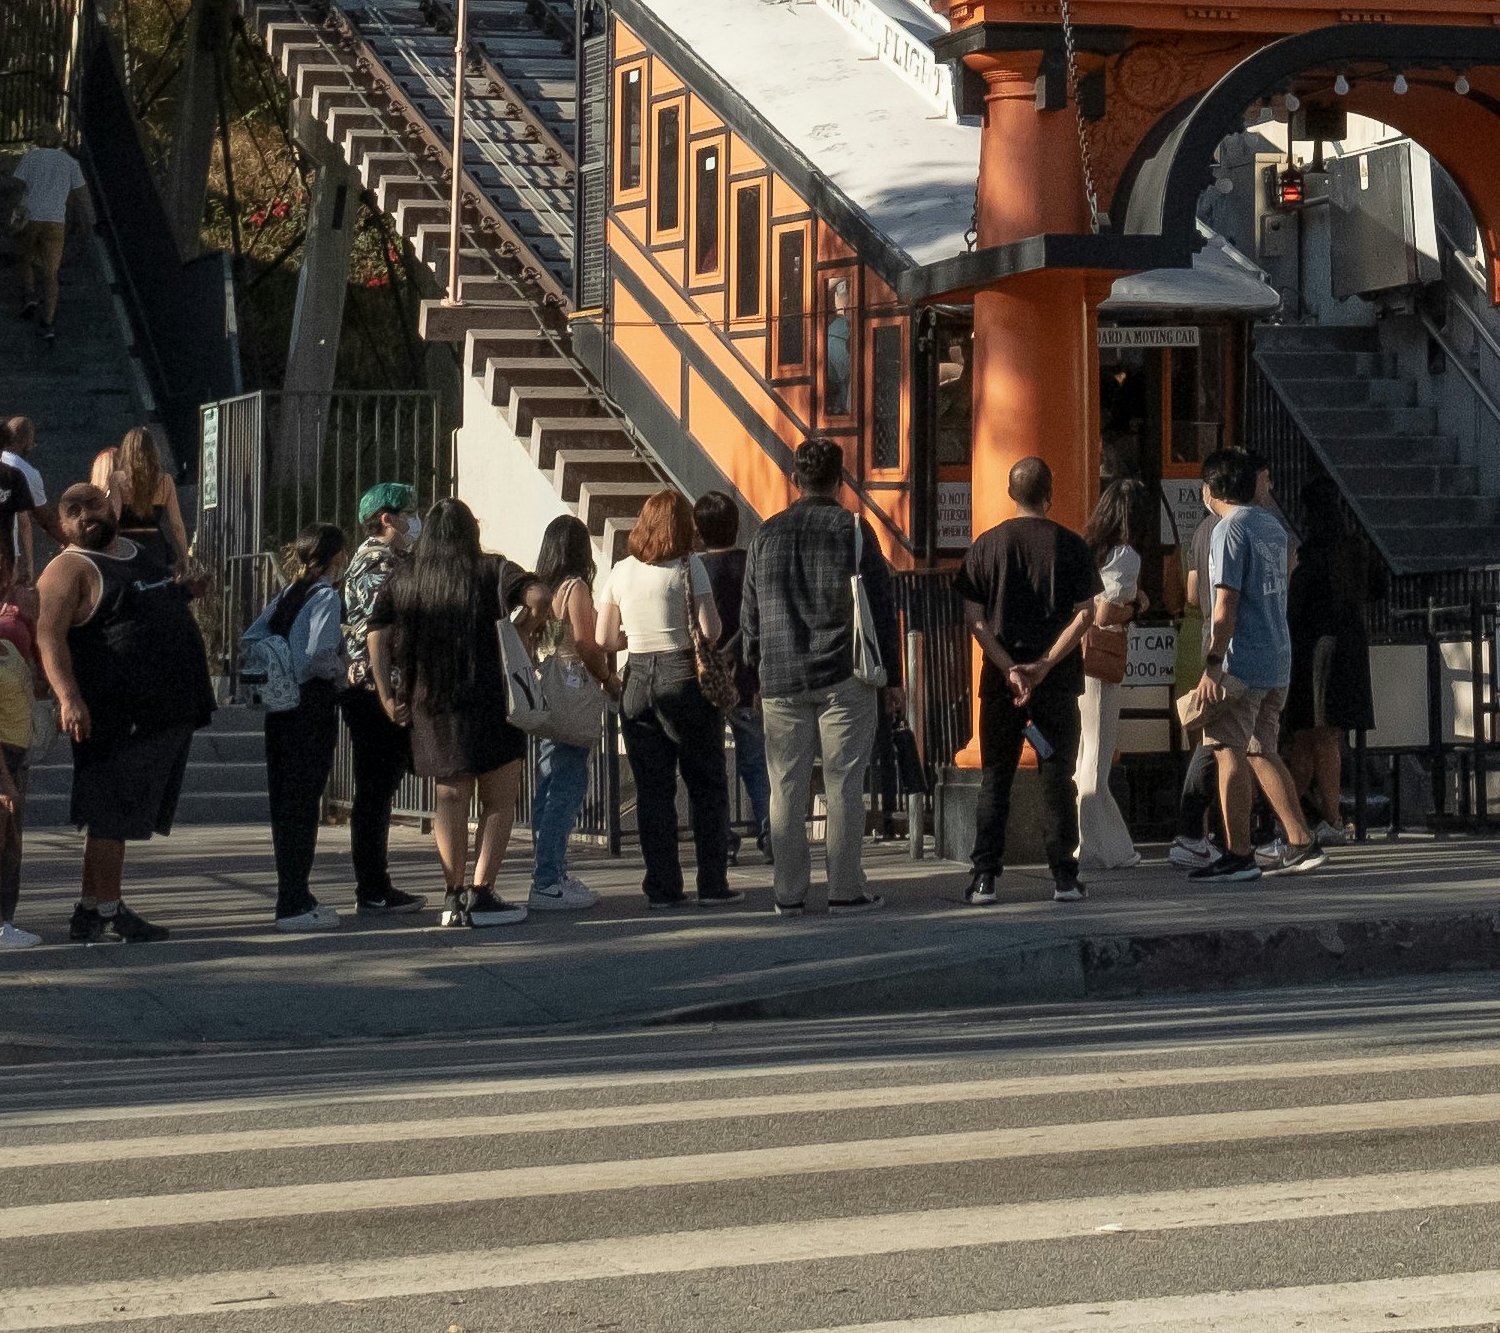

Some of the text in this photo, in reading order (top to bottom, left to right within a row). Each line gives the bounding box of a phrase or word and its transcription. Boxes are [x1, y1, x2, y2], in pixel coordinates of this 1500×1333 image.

[1097, 330, 1123, 345] ARD
[1134, 329, 1174, 344] MOVING
[1175, 329, 1196, 344] CAR
[1144, 635, 1175, 651] CAR
[1159, 665, 1174, 676] PM
